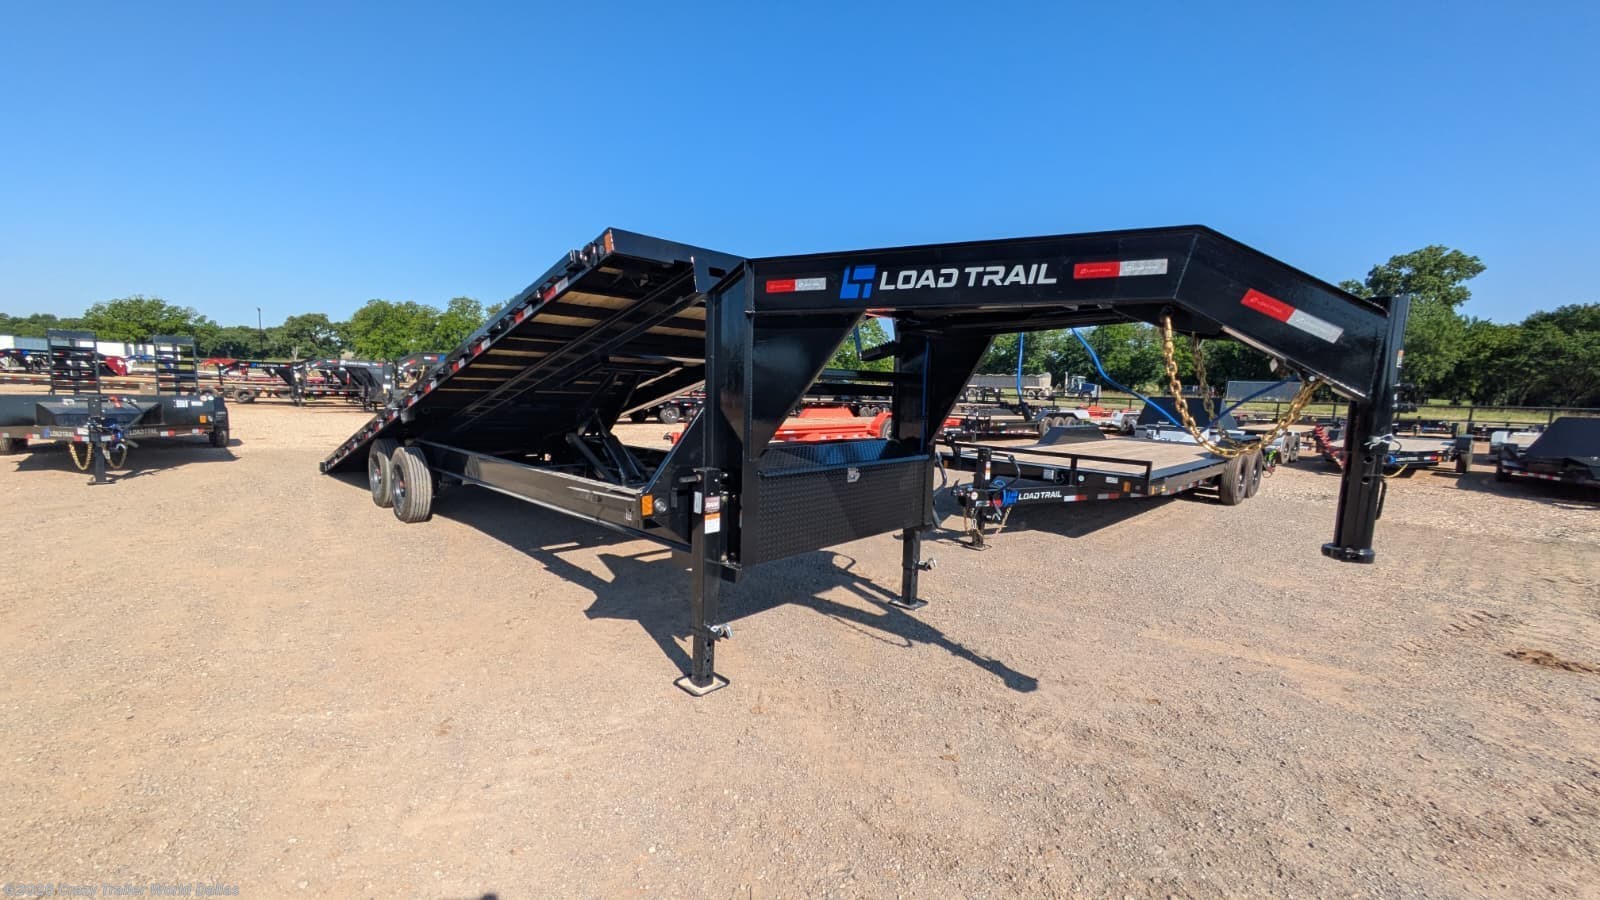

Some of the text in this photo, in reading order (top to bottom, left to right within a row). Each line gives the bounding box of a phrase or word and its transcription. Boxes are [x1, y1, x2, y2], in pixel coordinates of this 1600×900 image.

[879, 268, 959, 290] LOAD
[964, 263, 1058, 287] TRAIL
[1018, 491, 1062, 500] LOAD TRAIL
